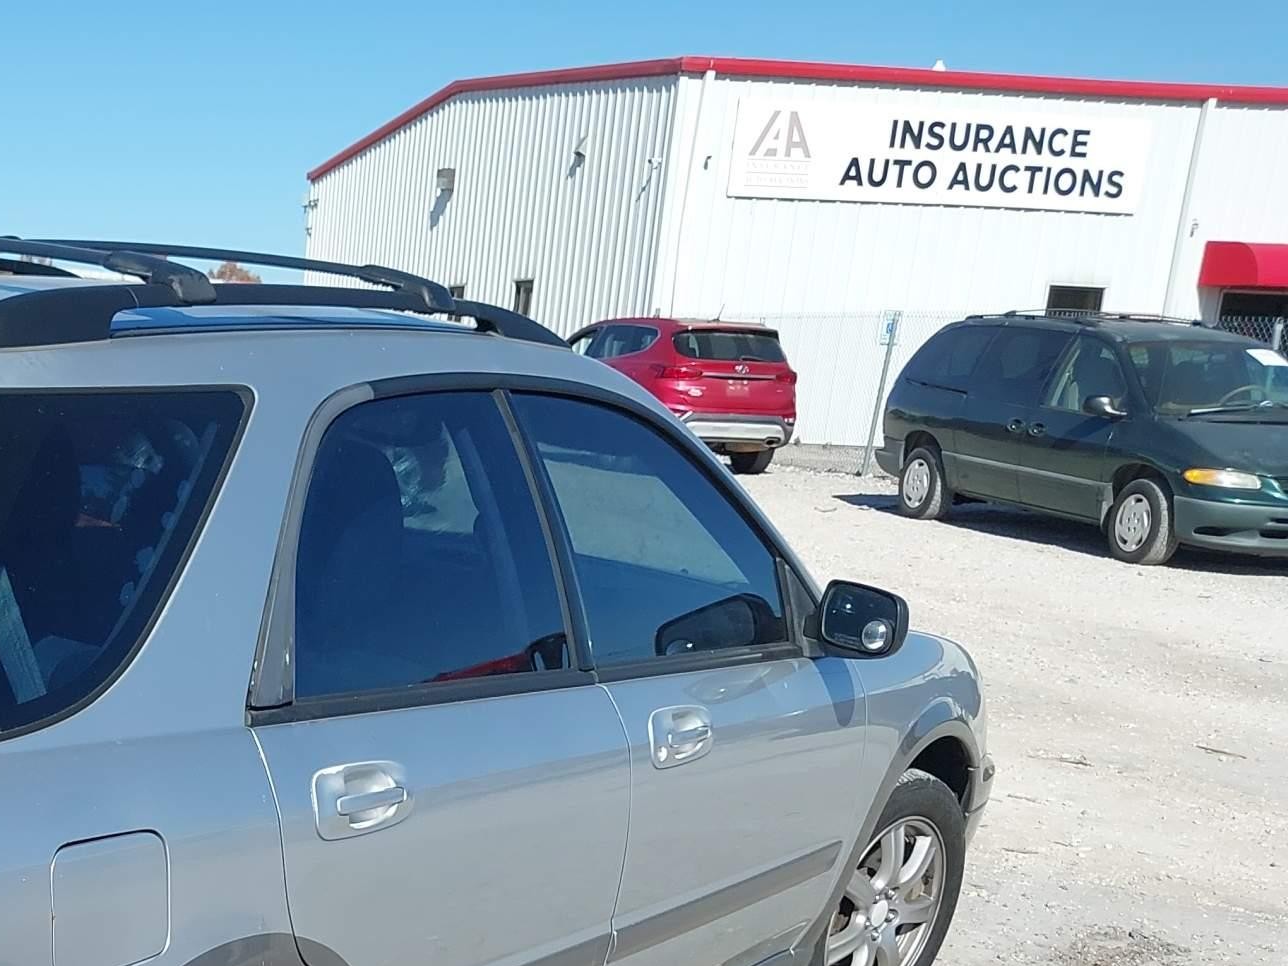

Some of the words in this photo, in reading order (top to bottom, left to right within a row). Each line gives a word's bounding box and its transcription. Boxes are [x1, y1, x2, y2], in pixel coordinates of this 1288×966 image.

[888, 119, 1091, 158] INSURANCE
[838, 157, 938, 190] AUTO
[946, 161, 1125, 199] AUCTIONS
